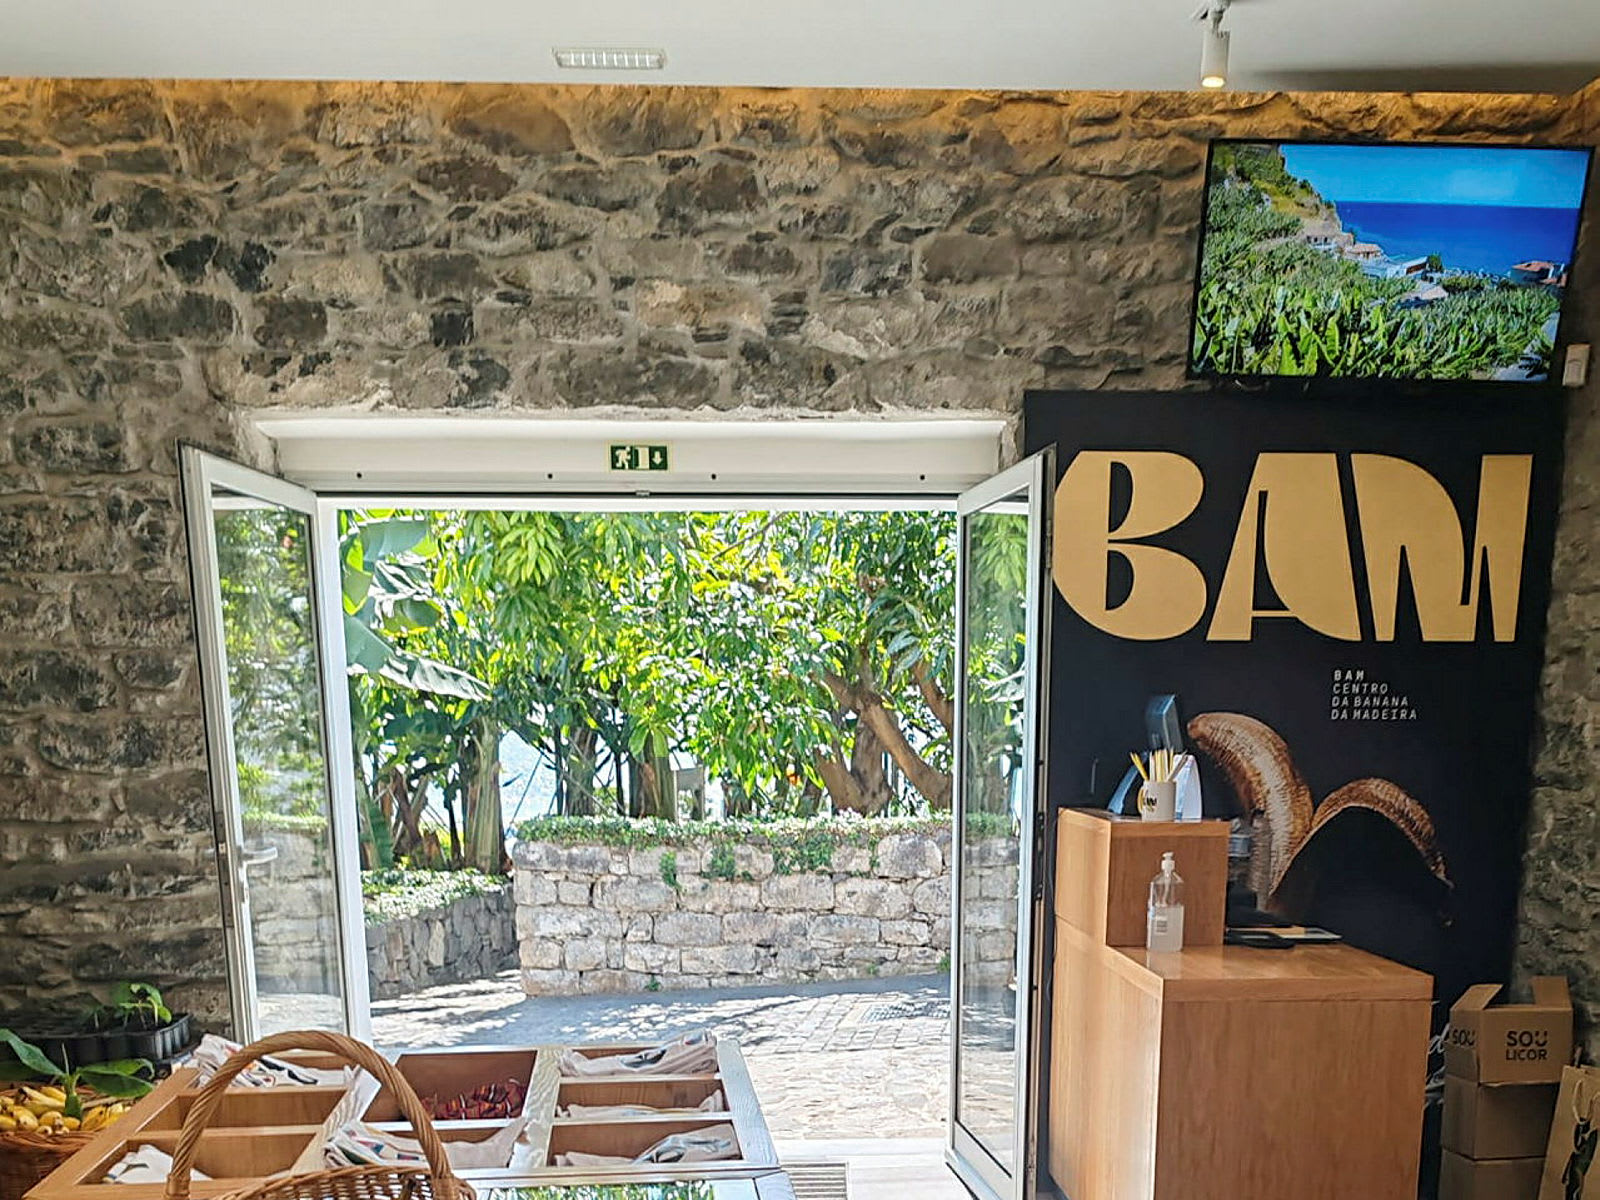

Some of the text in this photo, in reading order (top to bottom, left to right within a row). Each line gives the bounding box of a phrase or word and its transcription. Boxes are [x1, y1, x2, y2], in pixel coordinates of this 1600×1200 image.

[1052, 450, 1533, 642] BAM
[1333, 669, 1365, 681] BAM
[1332, 682, 1388, 695] CENTRO
[1331, 696, 1409, 708] DA BANANA
[1330, 708, 1418, 720] DA MADEIRA
[1505, 1048, 1548, 1061] LICOR
